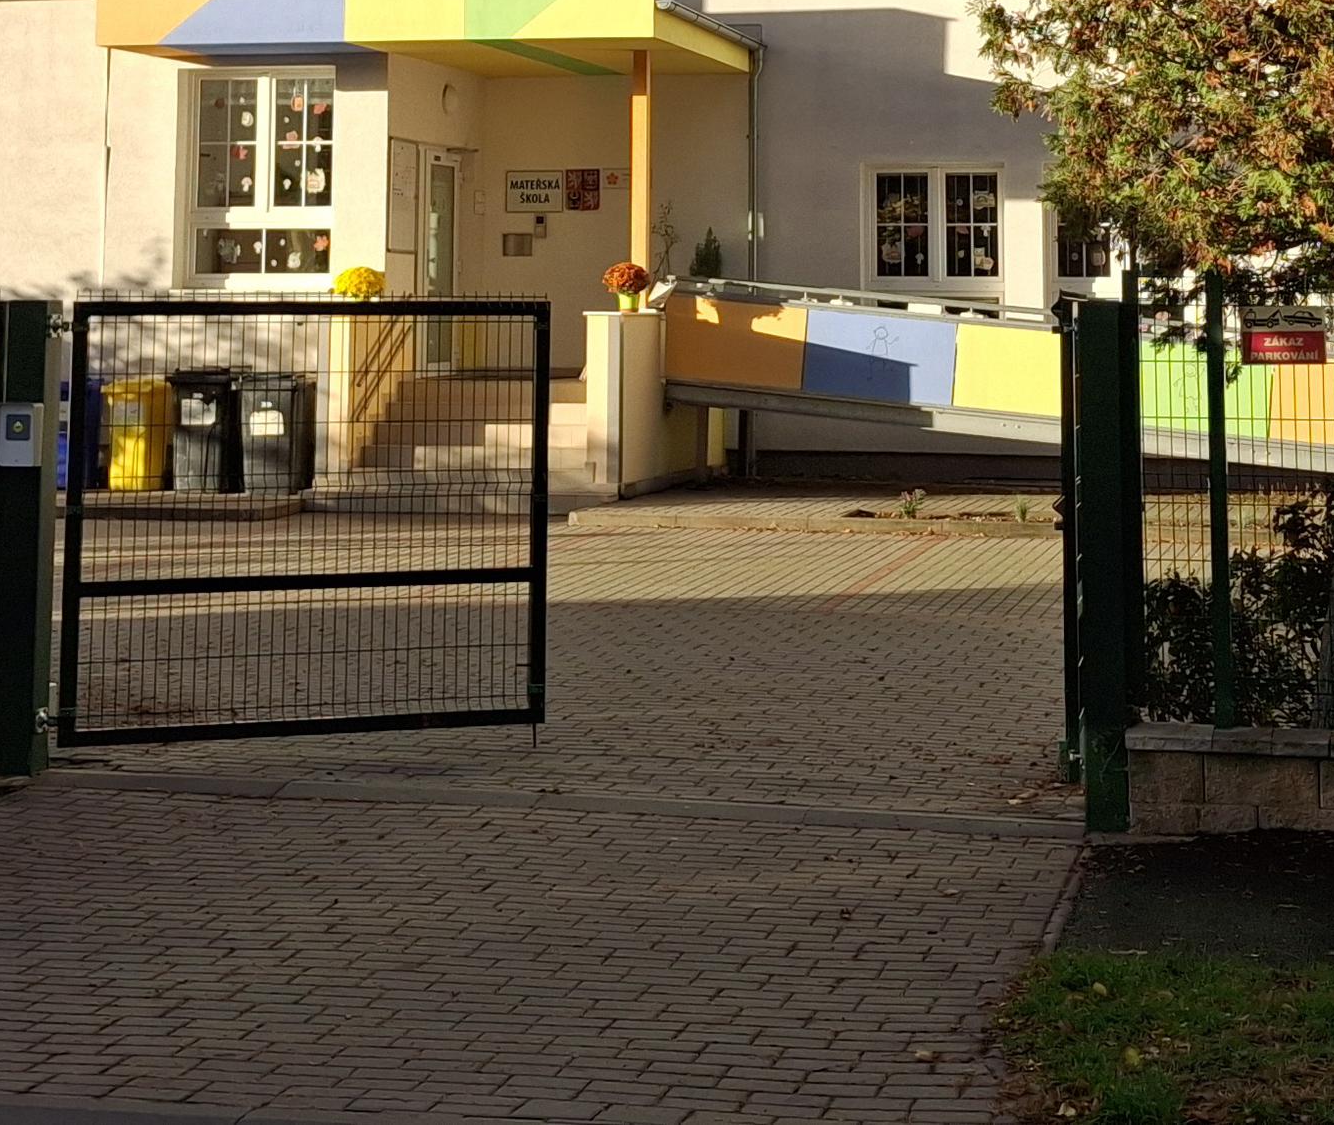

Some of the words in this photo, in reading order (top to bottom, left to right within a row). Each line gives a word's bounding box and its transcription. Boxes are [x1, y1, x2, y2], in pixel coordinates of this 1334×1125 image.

[510, 178, 560, 190] MATEŘSKÁ
[519, 192, 550, 204] ŠKOLA
[1263, 335, 1304, 347] ZÁKAZ
[1250, 349, 1319, 361] PARKOVÁNÍ
